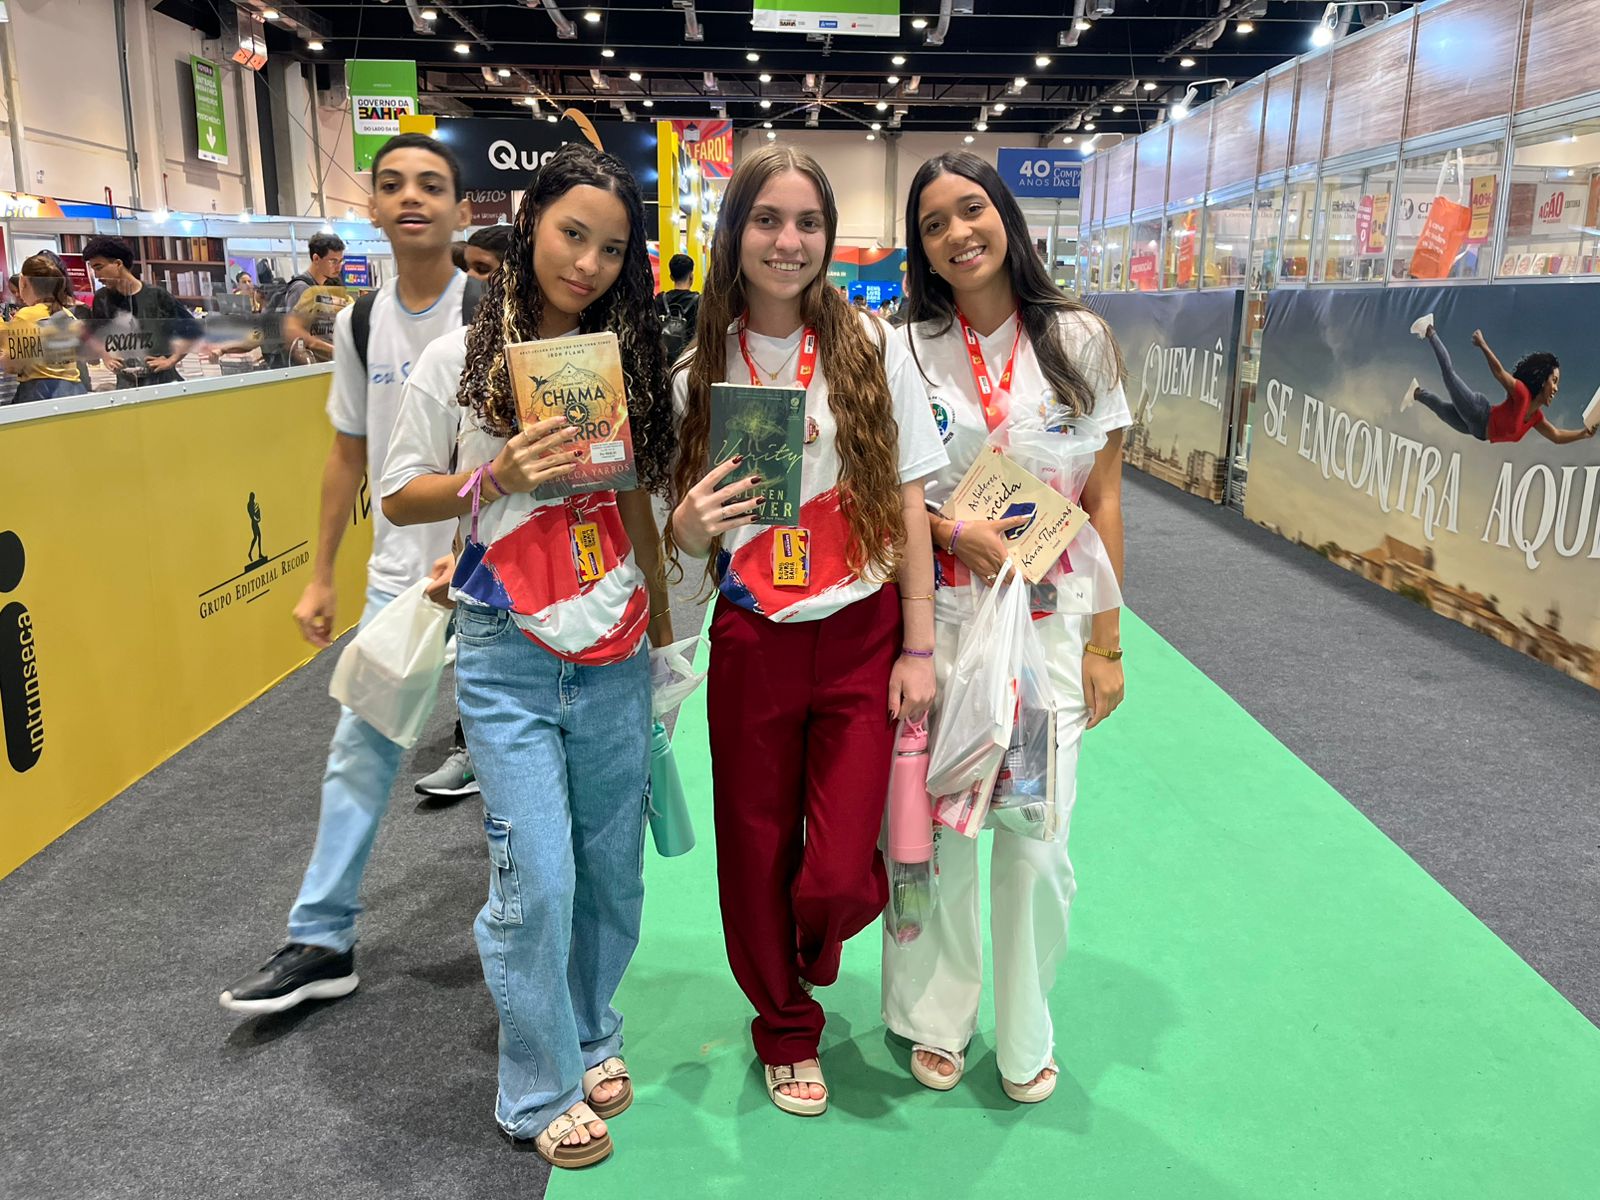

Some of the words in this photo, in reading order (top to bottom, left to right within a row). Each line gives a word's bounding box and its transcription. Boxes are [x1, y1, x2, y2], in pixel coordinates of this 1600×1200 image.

[358, 99, 397, 107] GOVERNO
[358, 106, 409, 120] BAHIA
[488, 140, 568, 171] Qua
[694, 136, 729, 162] FAROL
[1019, 160, 1051, 178] 40
[1018, 178, 1050, 187] ANOS
[1053, 177, 1070, 187] DAS
[8, 336, 44, 360] BARRA
[1137, 342, 1197, 423] QUEM
[542, 385, 606, 407] CHAMA
[713, 438, 804, 474] Vrity
[591, 463, 632, 478] YARROS
[1263, 378, 1294, 446] SE
[1297, 393, 1462, 541] ENCONTRA
[1480, 461, 1600, 569] AQU
[968, 498, 979, 512] As
[1021, 544, 1044, 568] Kara
[1038, 506, 1073, 543] Thomas
[199, 592, 232, 619] GRUPO
[235, 568, 278, 600] EDITORIAL
[281, 551, 310, 576] RECORD
[18, 611, 45, 753] intrinseca
